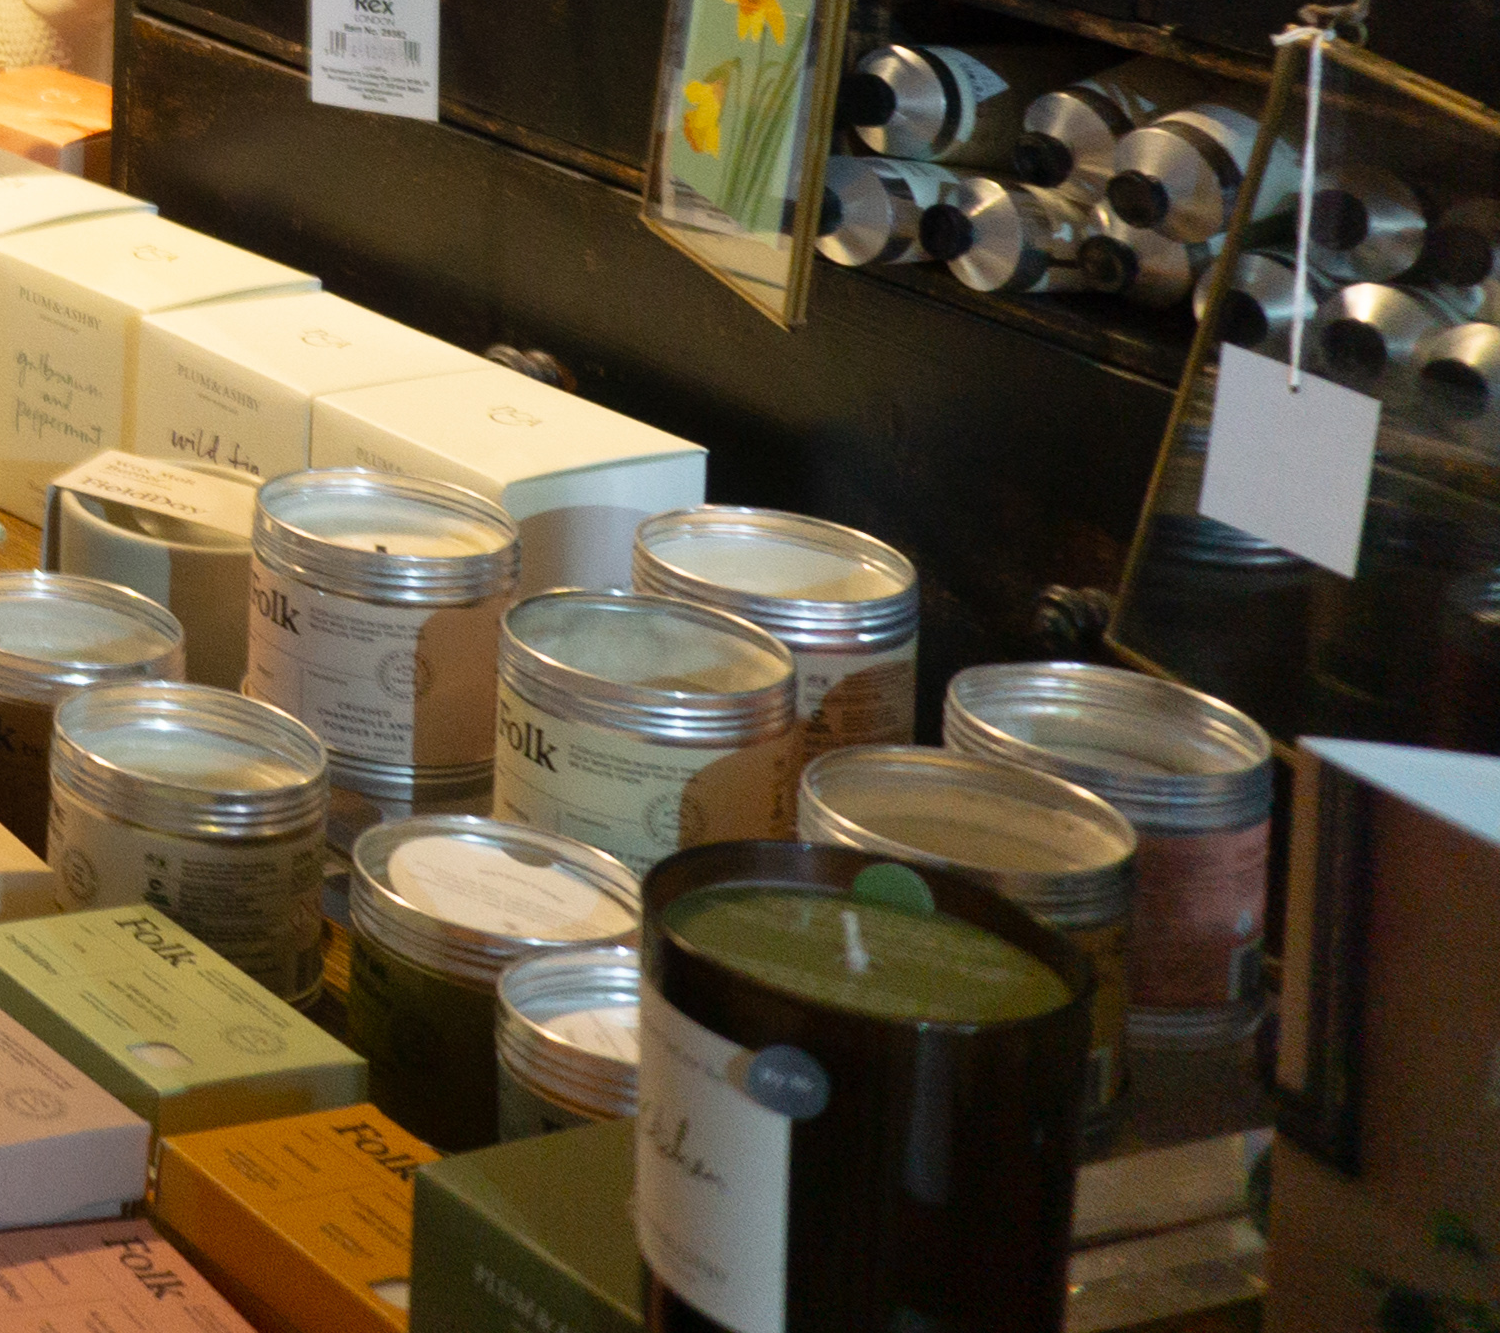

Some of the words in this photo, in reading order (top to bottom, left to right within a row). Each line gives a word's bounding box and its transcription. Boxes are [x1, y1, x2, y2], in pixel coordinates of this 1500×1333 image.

[354, 15, 395, 26] LONDON
[19, 286, 52, 311] PLUM
[64, 303, 102, 331] ASHBY
[42, 390, 74, 415] and
[176, 364, 210, 390] PLUM
[222, 383, 260, 412] ASHBY
[15, 397, 102, 446] peppermint
[171, 429, 219, 465] wild
[83, 477, 210, 513] FieldDay
[113, 917, 198, 969] Folk
[103, 1235, 188, 1301] Folk
